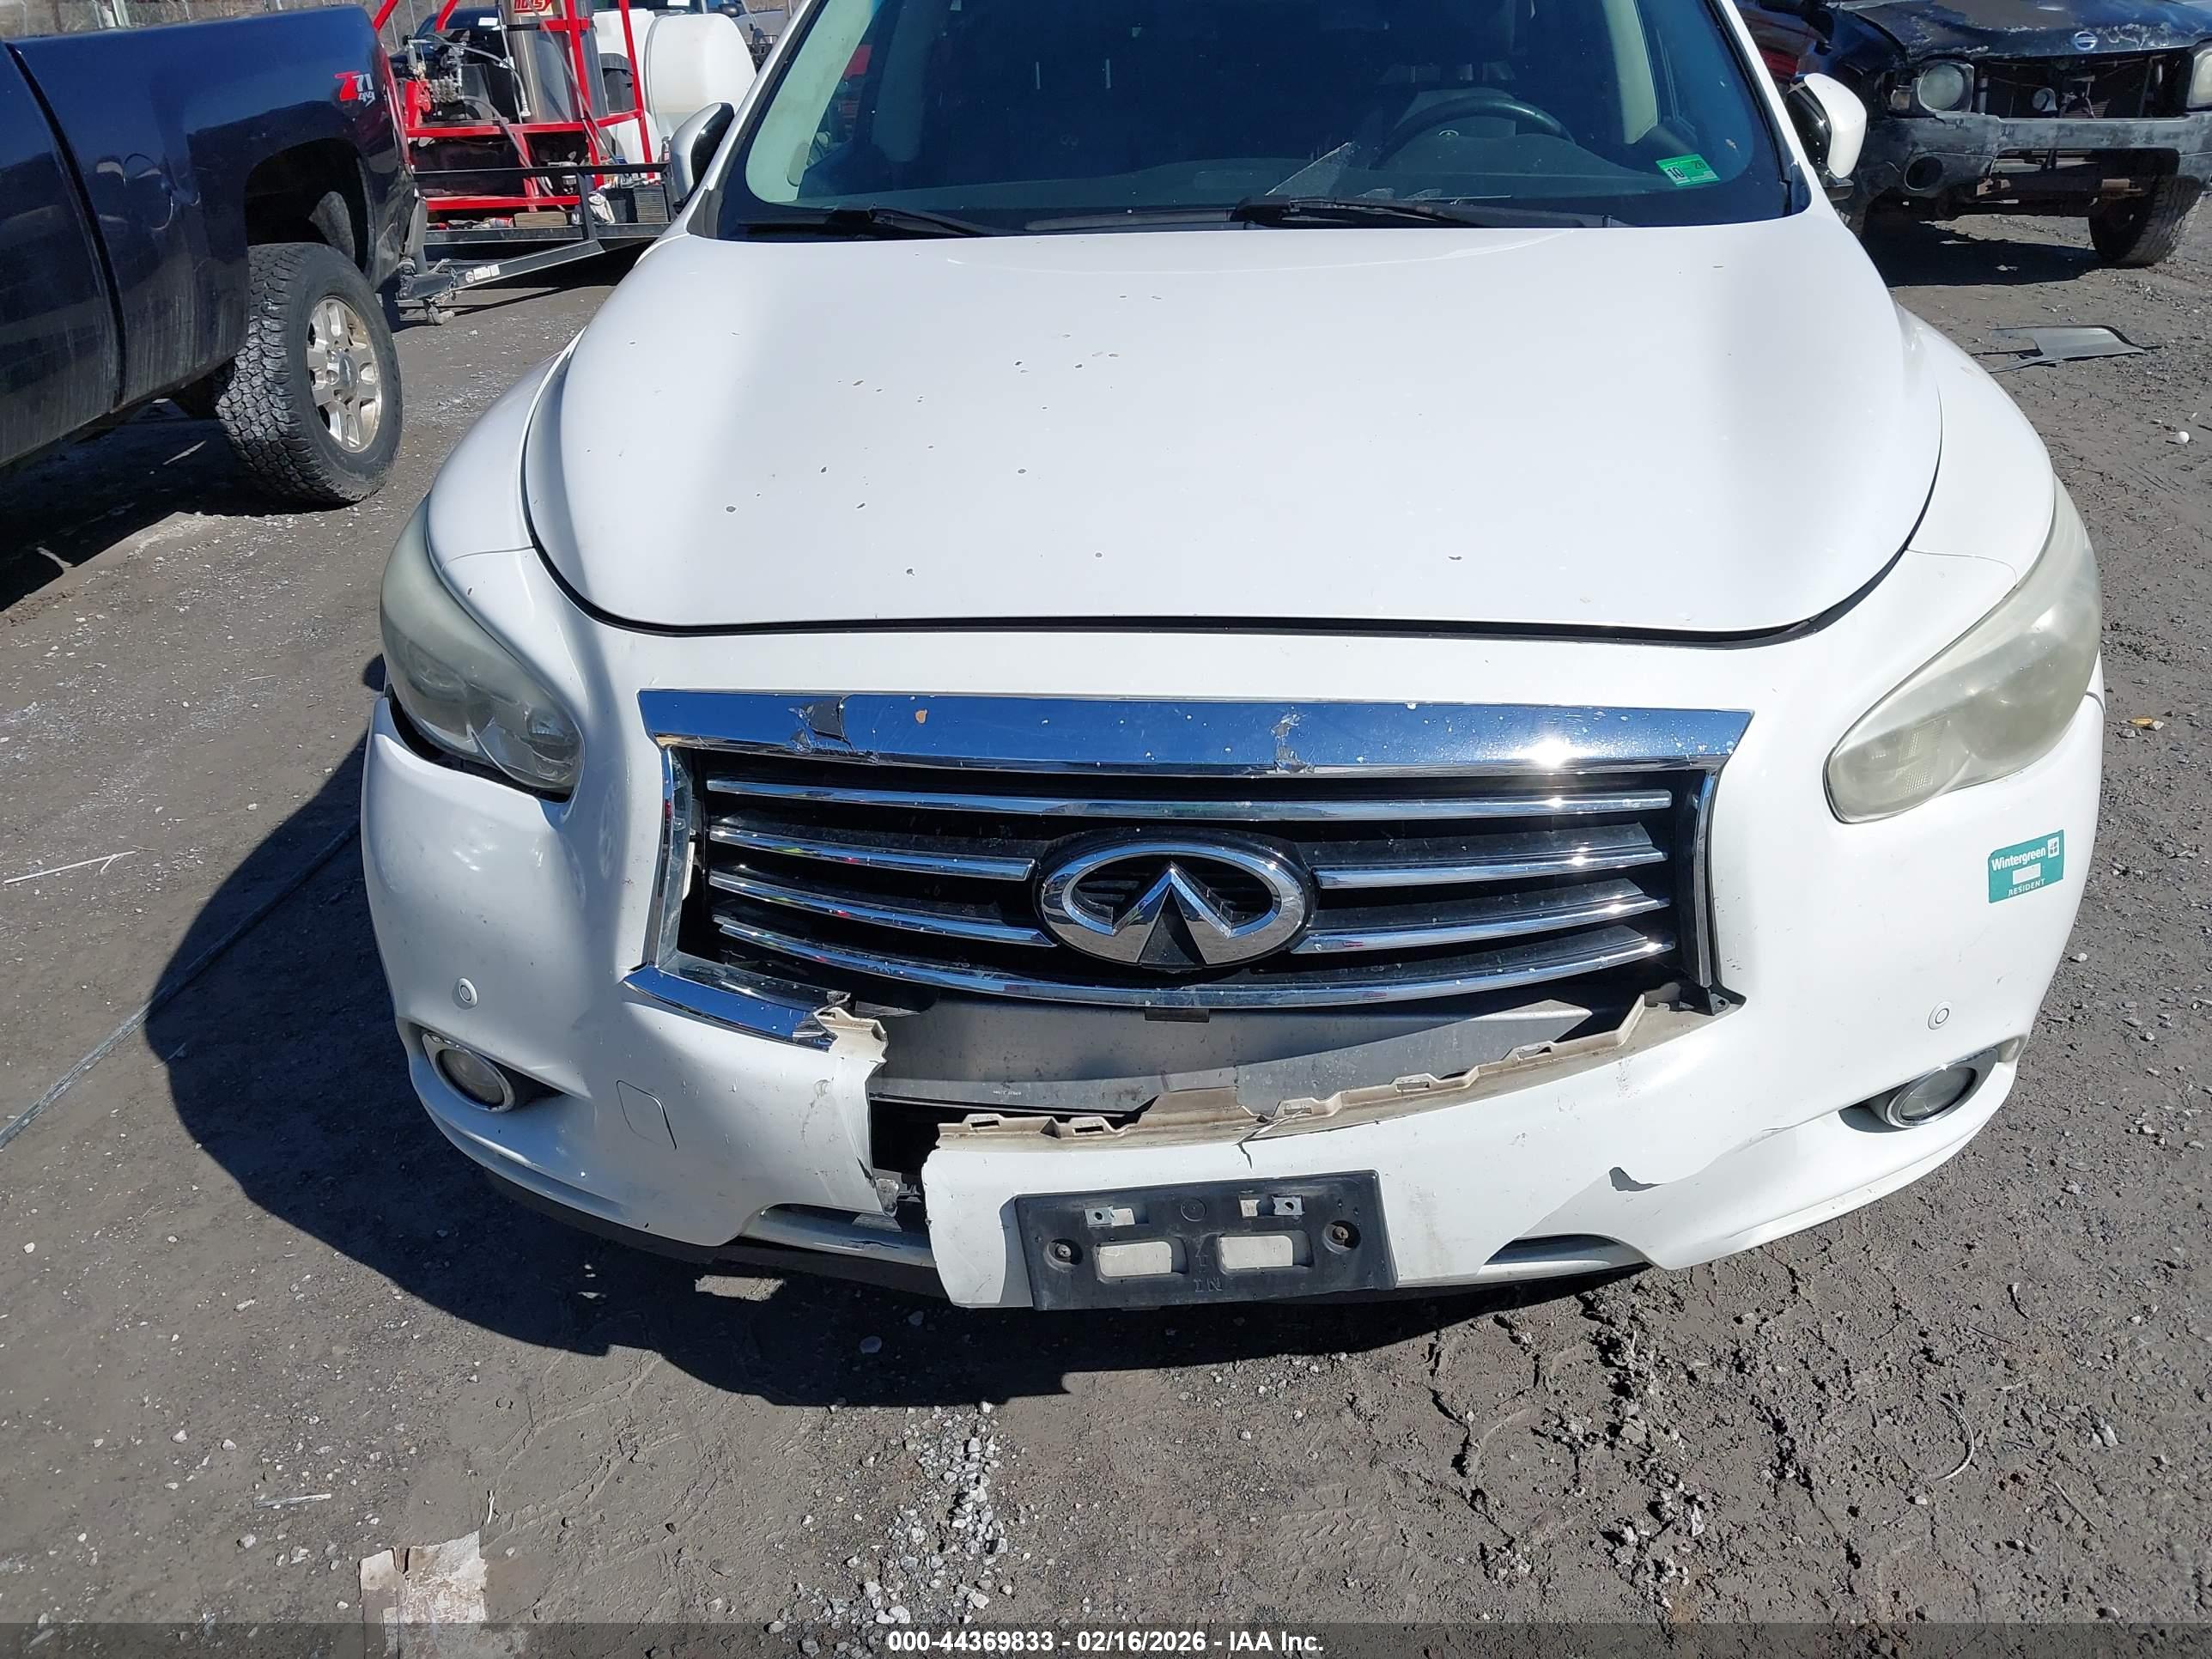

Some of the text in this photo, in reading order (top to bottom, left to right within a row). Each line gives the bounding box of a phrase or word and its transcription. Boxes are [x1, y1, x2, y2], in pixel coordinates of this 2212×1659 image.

[335, 70, 374, 101] Z71
[1668, 167, 1685, 179] 10
[1991, 847, 2046, 872] Wintergreen
[2008, 878, 2046, 896] RESIDENT
